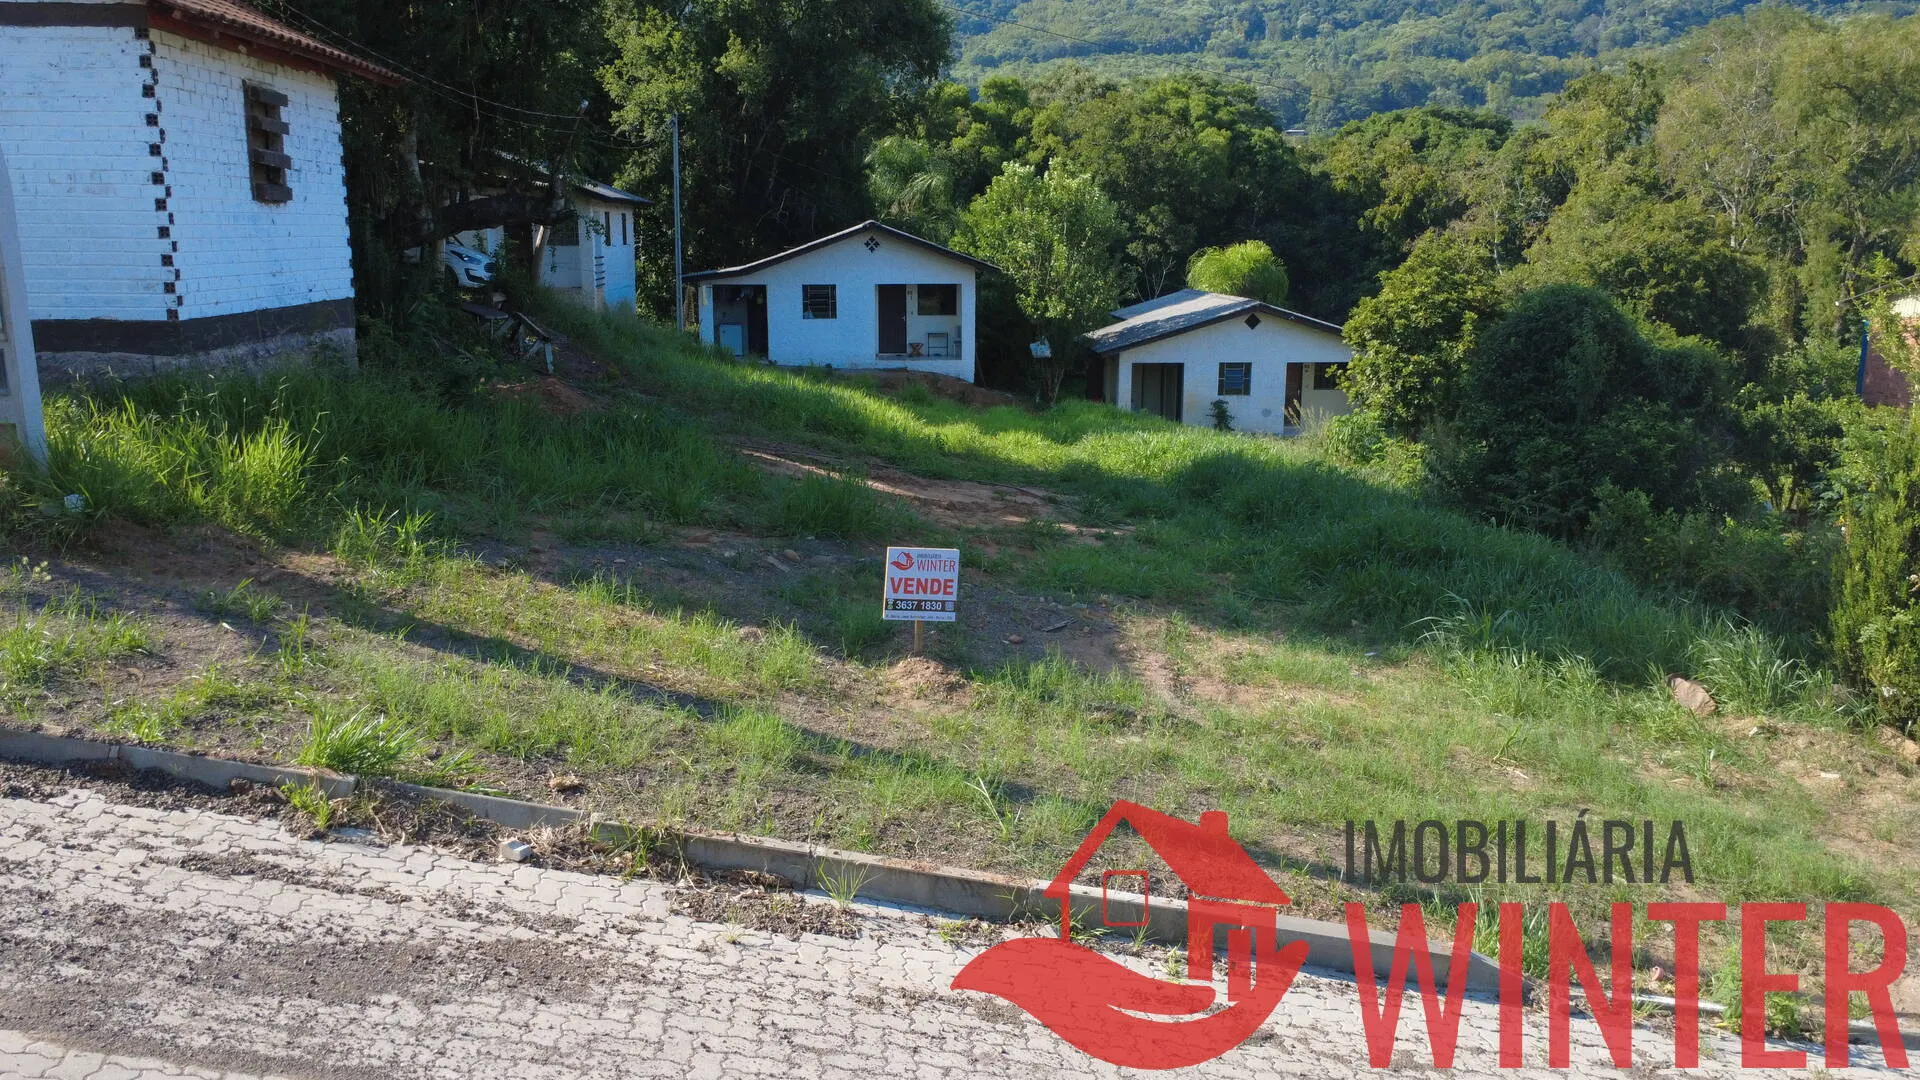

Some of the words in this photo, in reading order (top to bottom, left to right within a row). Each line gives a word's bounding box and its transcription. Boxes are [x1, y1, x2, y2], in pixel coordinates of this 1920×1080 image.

[917, 559, 956, 572] WINTER
[890, 577, 954, 596] VENDE
[895, 601, 918, 610] 3637
[920, 602, 942, 610] 1830
